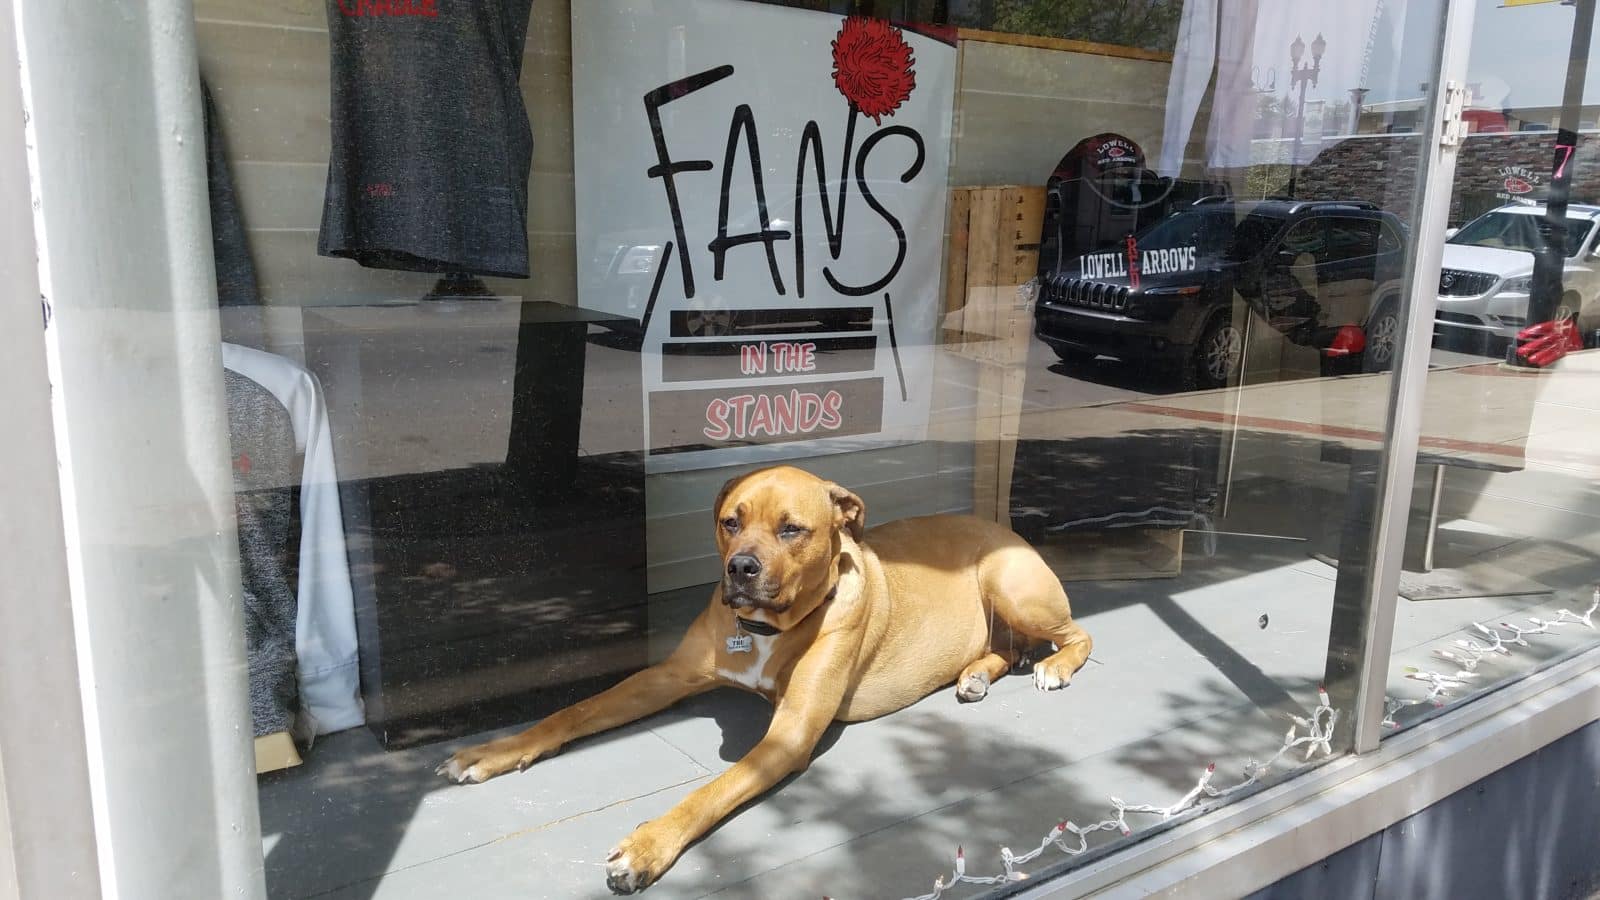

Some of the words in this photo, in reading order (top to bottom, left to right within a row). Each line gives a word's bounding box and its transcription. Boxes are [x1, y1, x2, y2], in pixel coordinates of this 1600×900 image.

[1097, 140, 1135, 154] LOWELL
[644, 65, 925, 298] FANS
[1498, 166, 1540, 184] LOWELL
[1080, 252, 1127, 280] LOWELL
[1127, 238, 1140, 289] RED
[1142, 246, 1196, 275] ARROWS
[741, 341, 767, 374] IN
[770, 343, 816, 373] THE
[704, 388, 842, 440] STANDS
